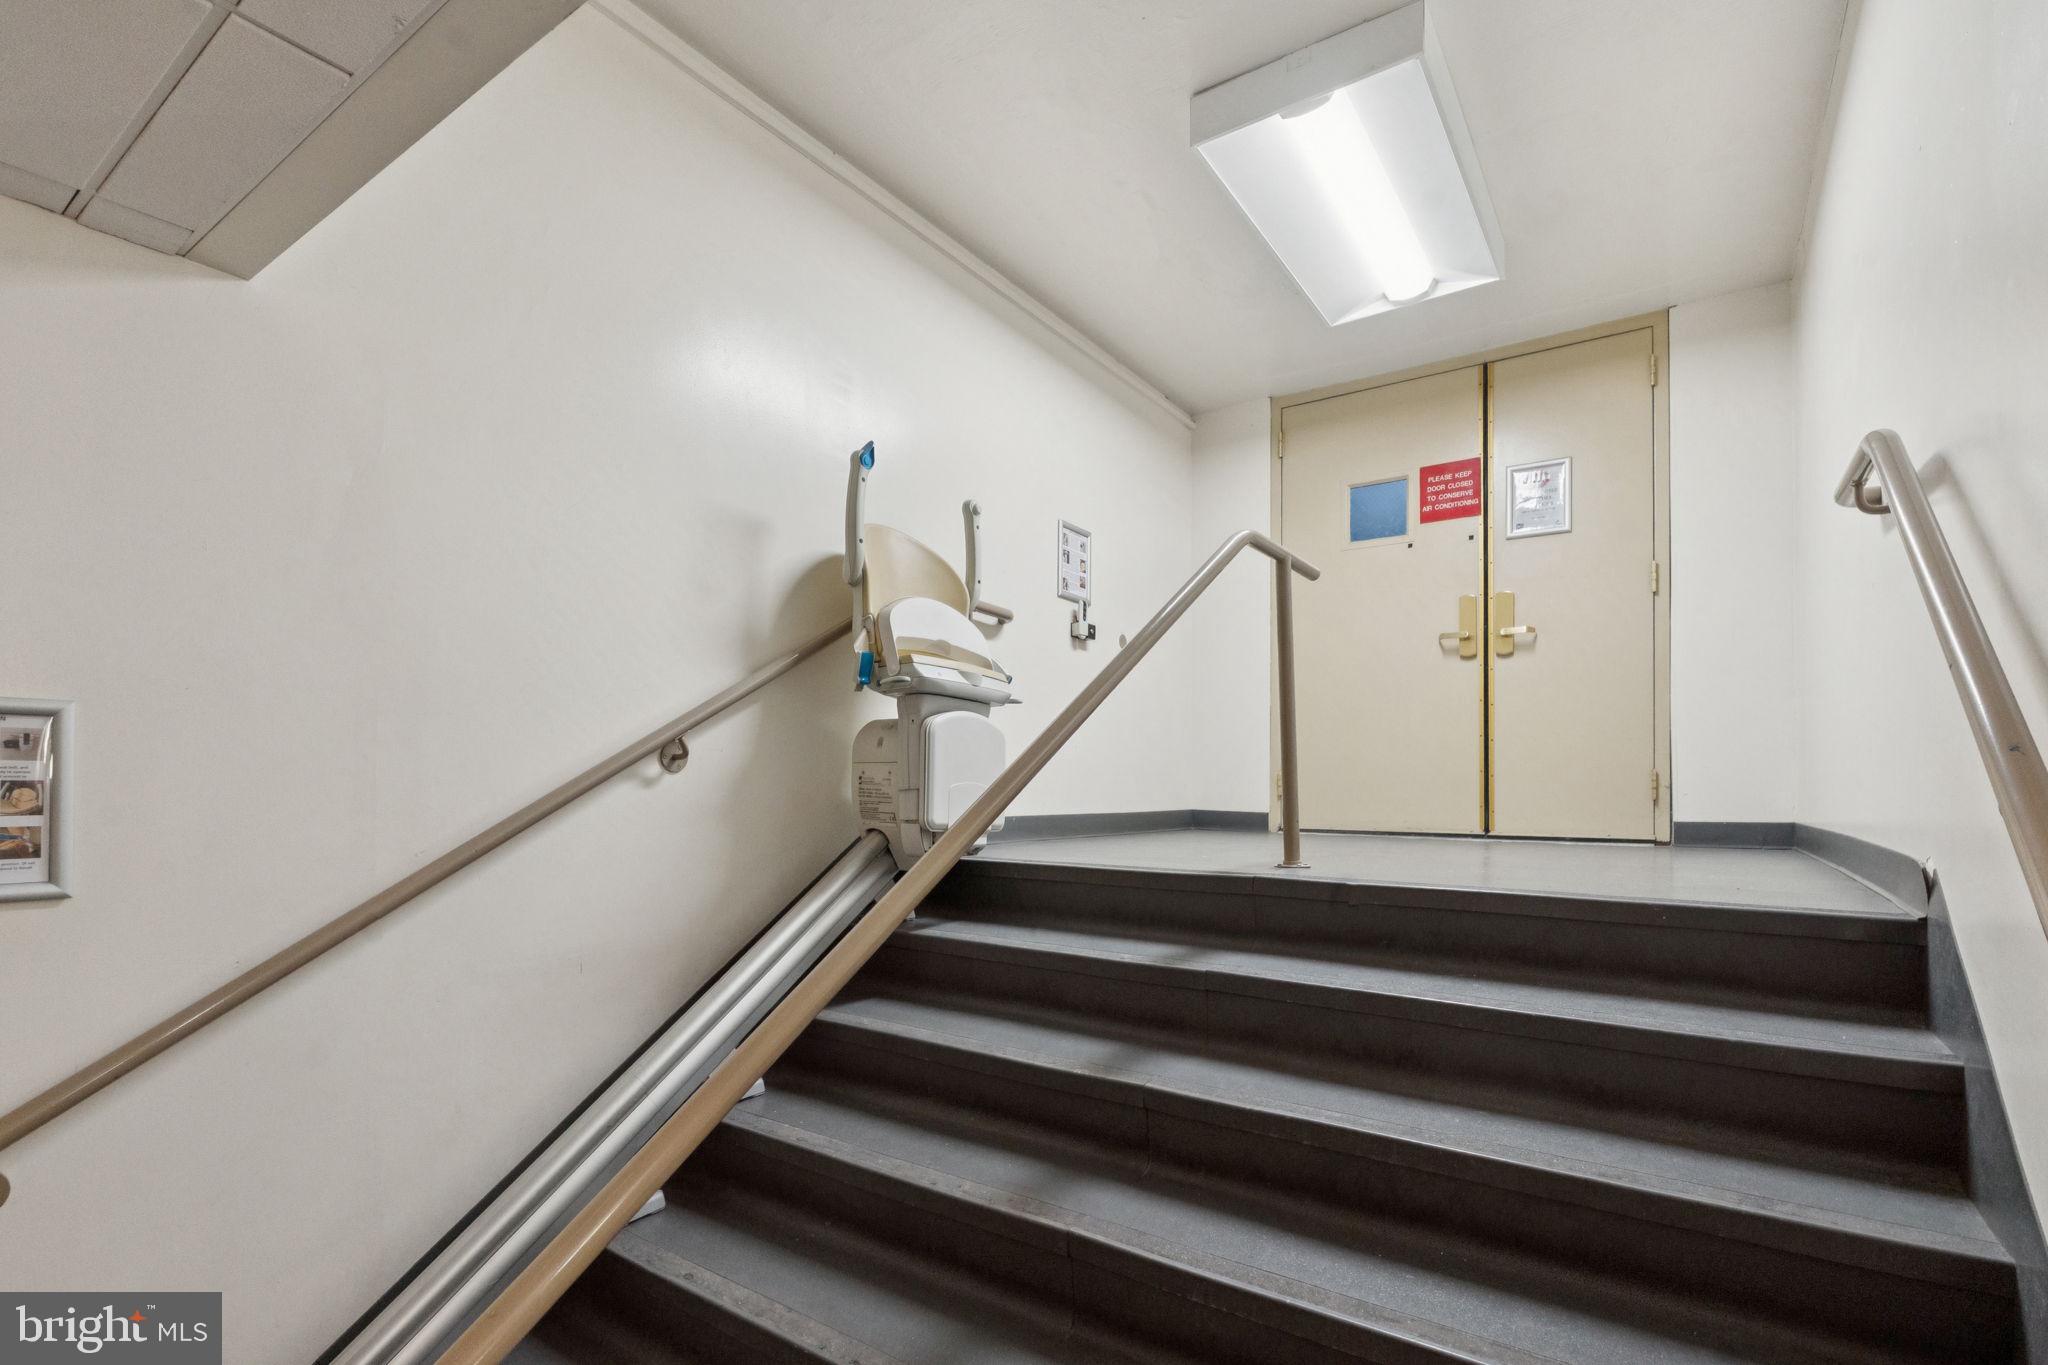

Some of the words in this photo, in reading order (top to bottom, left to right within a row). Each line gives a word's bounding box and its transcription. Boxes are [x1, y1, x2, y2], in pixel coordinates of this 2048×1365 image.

[1428, 474, 1453, 482] PLEASE
[1455, 470, 1472, 478] KEEP
[1427, 485, 1446, 493] DOOR
[1448, 480, 1473, 489] CLOSED
[1438, 489, 1473, 500] CONSERVE
[1434, 498, 1479, 510] CONDITIONING
